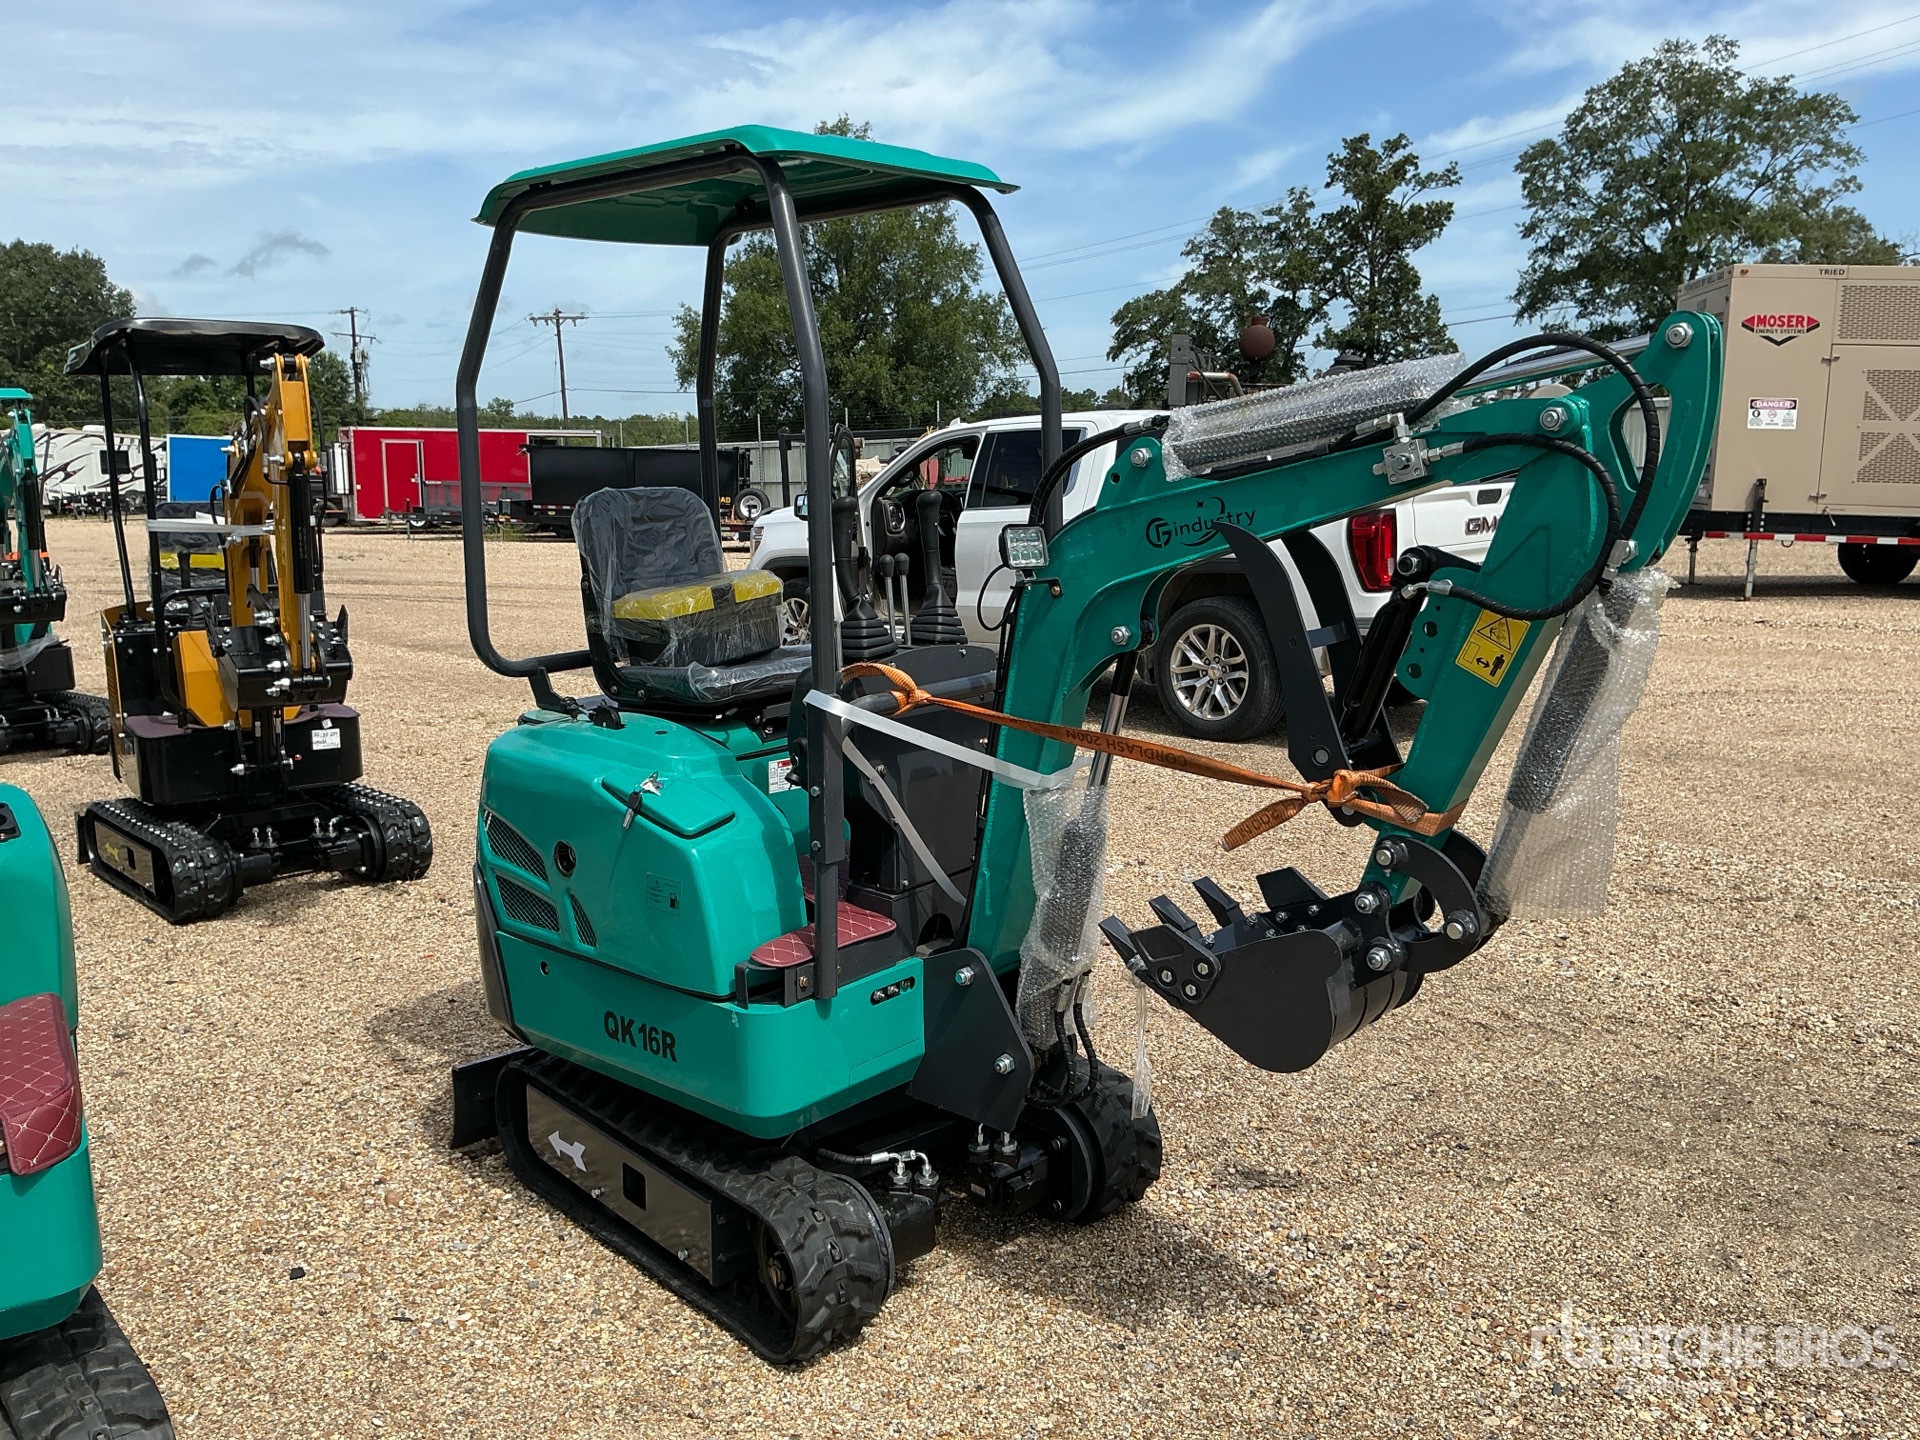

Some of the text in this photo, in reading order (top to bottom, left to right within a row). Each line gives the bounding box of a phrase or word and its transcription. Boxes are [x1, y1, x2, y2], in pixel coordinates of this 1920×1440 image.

[1819, 268, 1845, 276] TRIED
[1755, 314, 1806, 328] MOSER
[1066, 729, 1188, 767] CORDLASH 200N
[604, 1010, 678, 1063] QK16R
